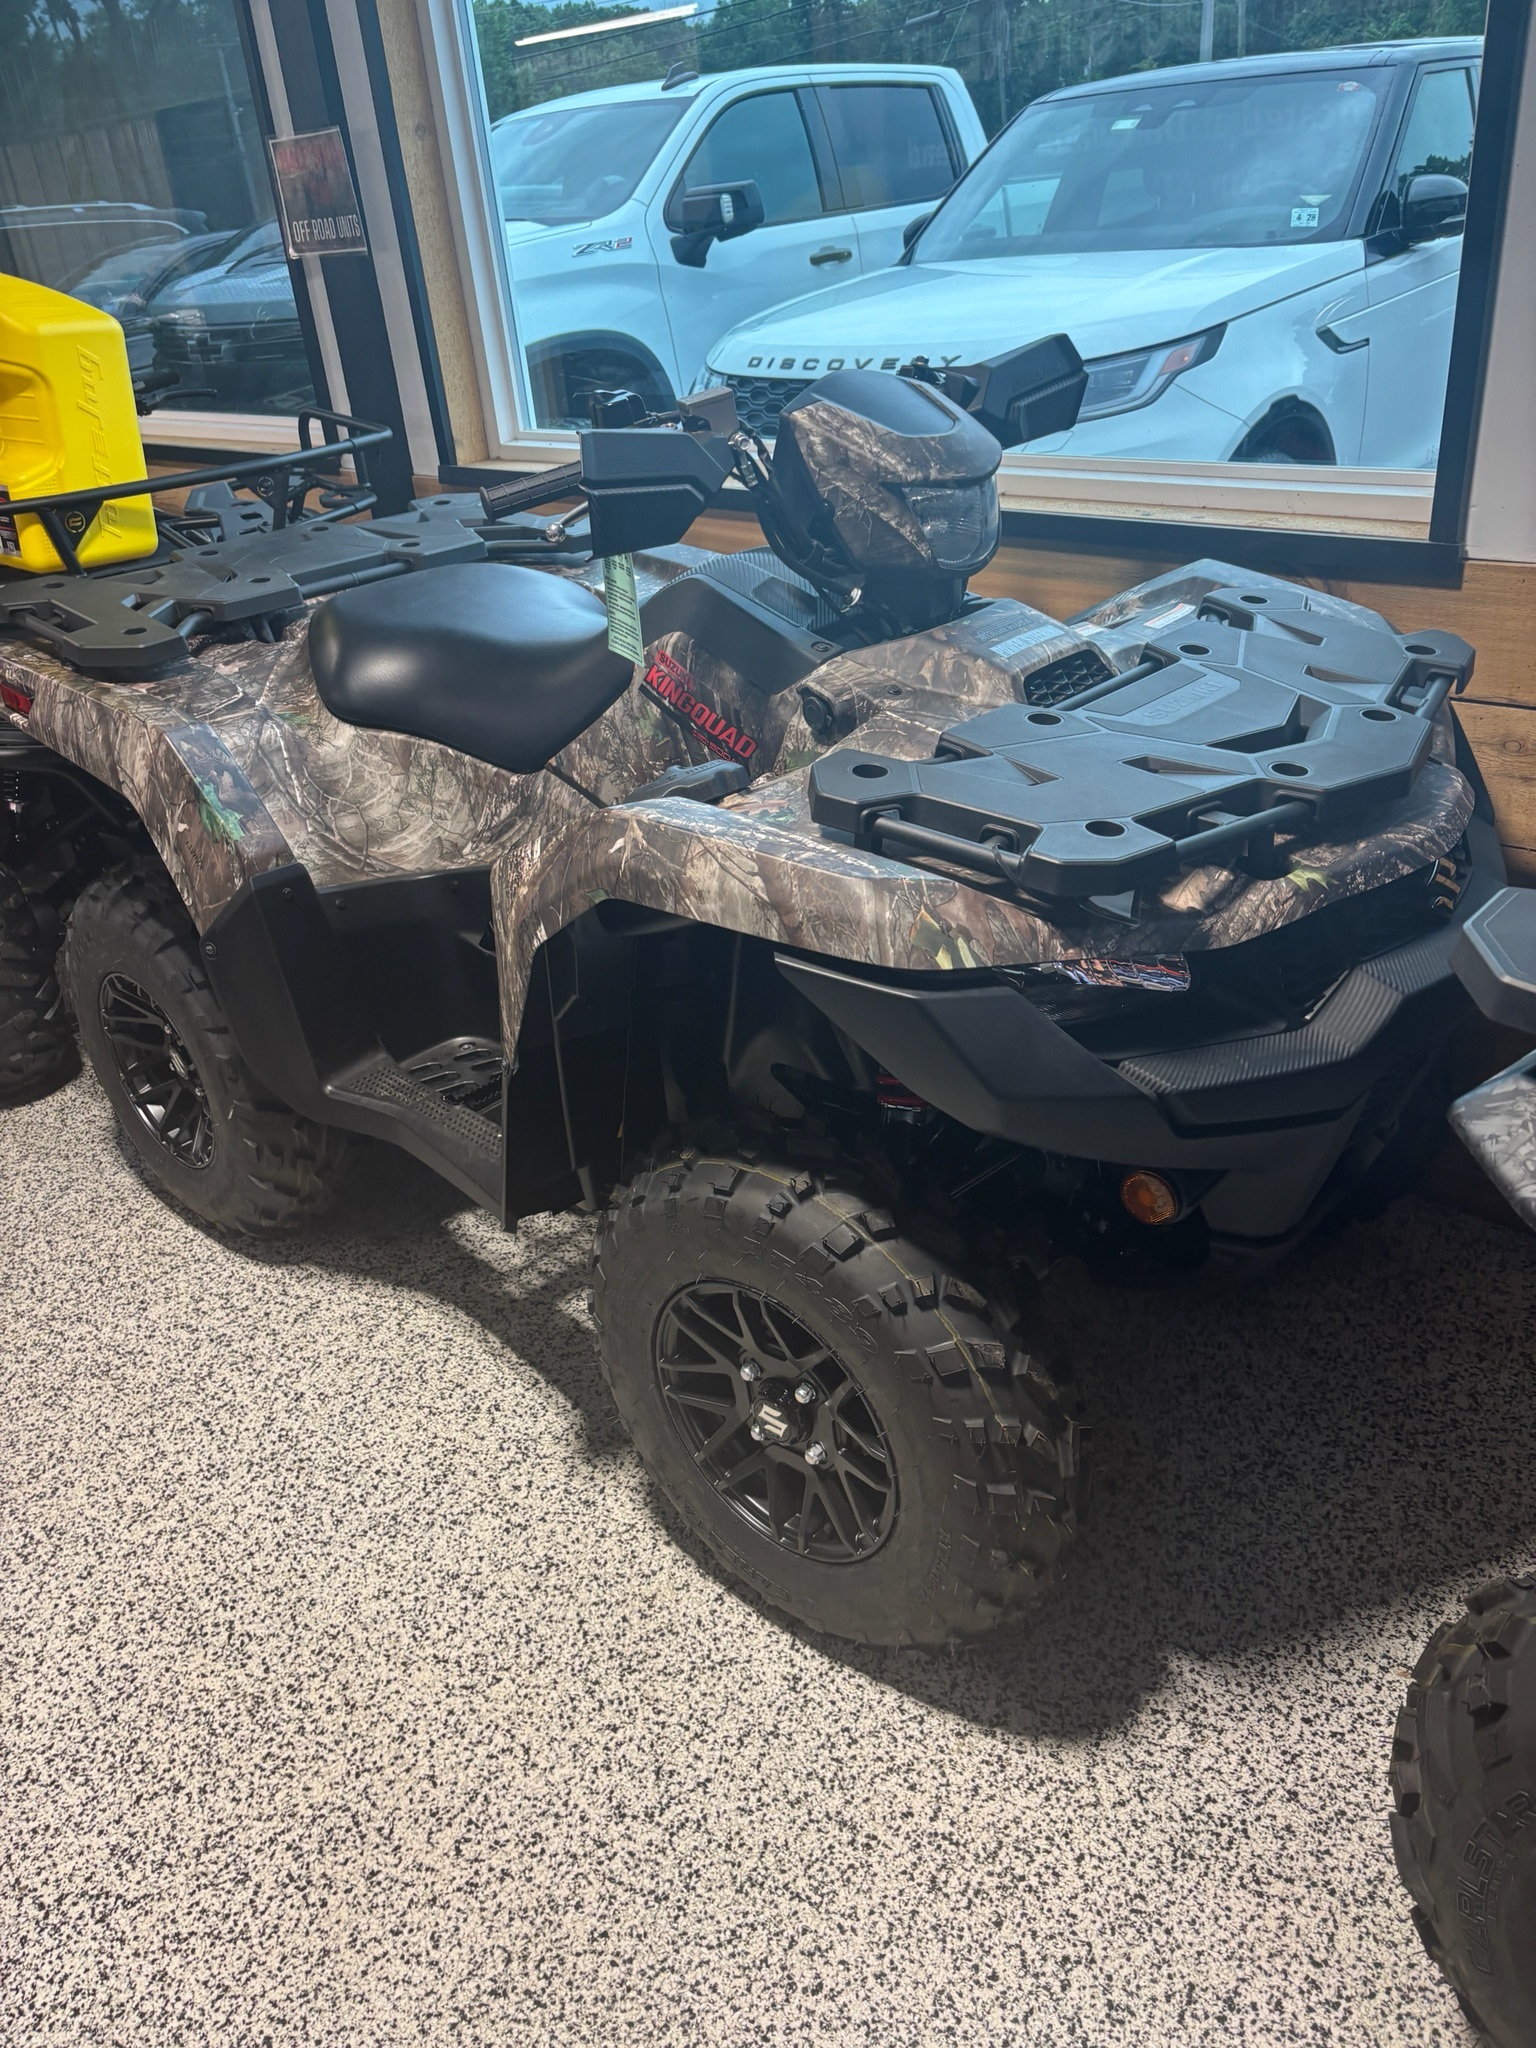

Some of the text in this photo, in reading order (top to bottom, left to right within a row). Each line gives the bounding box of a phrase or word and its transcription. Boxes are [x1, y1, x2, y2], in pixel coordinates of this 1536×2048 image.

[292, 213, 361, 243] OFF ROAD UNITS
[572, 237, 632, 258] ZR2
[747, 354, 963, 371] DISCOVEY
[645, 664, 757, 758] KINGQUAD
[1142, 681, 1226, 720] SUZUKI
